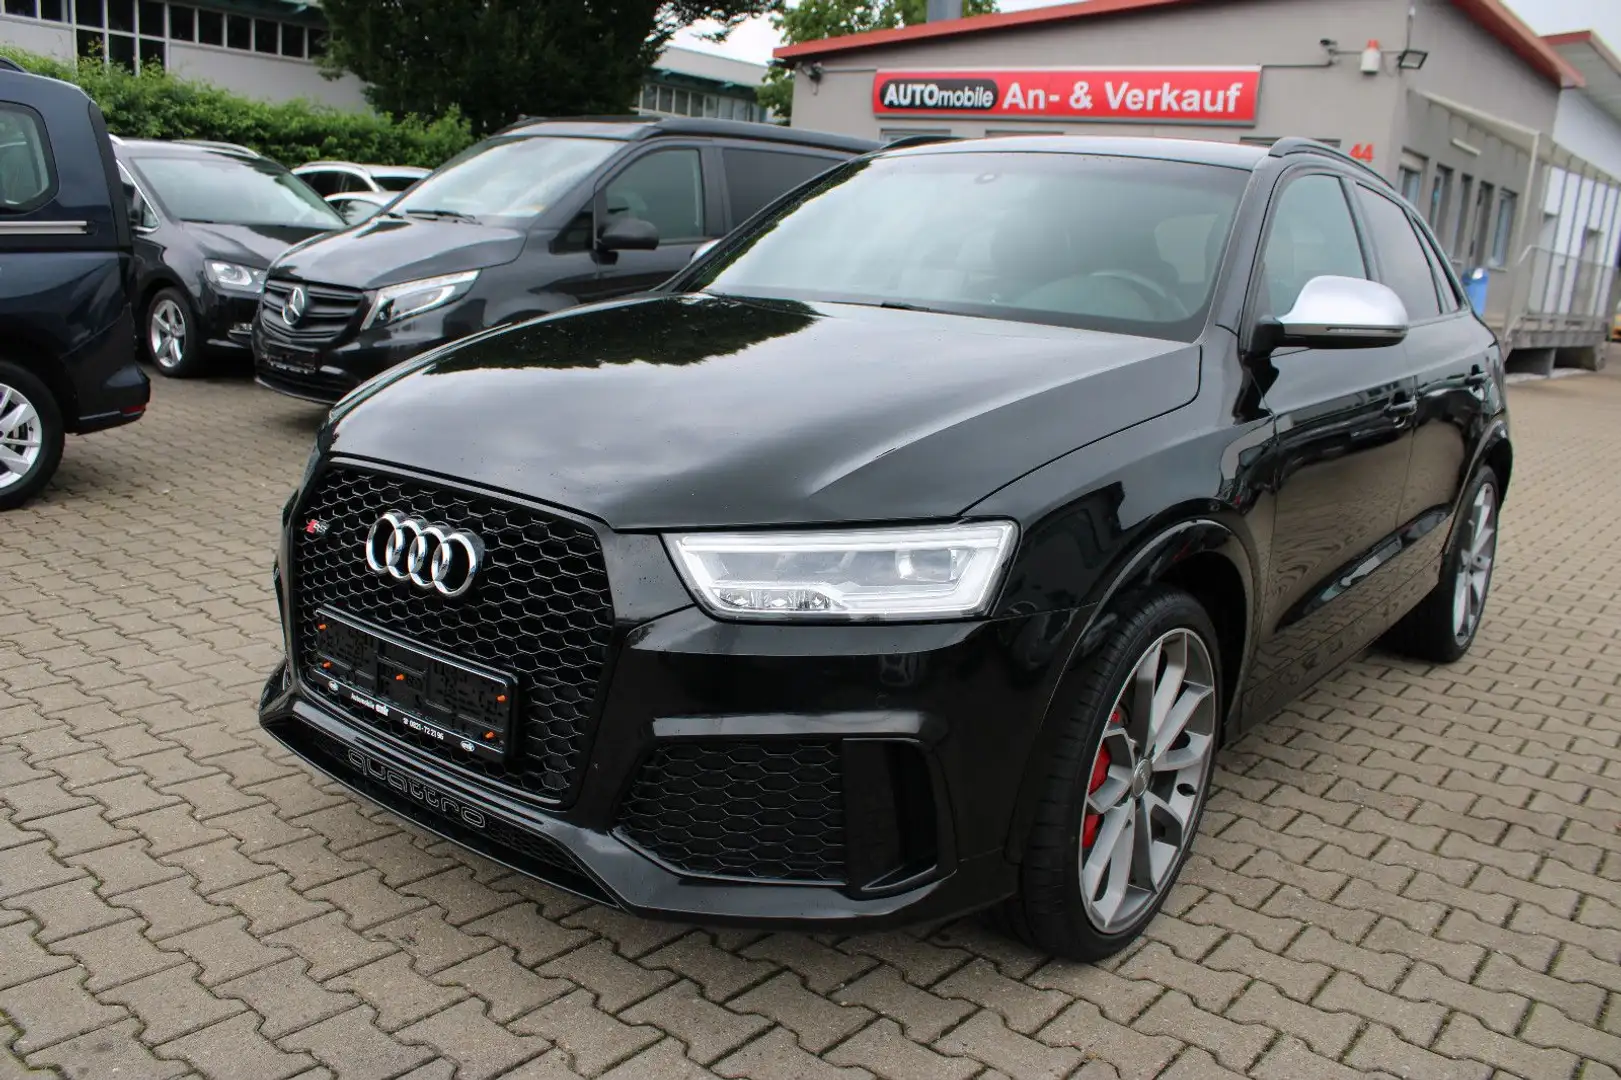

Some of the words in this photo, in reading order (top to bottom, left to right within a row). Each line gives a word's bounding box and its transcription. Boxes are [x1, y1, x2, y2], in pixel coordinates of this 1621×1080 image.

[883, 82, 994, 109] AUTOmobile
[1002, 81, 1060, 110] An-
[1068, 80, 1094, 111] &
[1104, 81, 1244, 113] Verkauf
[1349, 143, 1374, 163] 44
[347, 749, 486, 829] quattro
